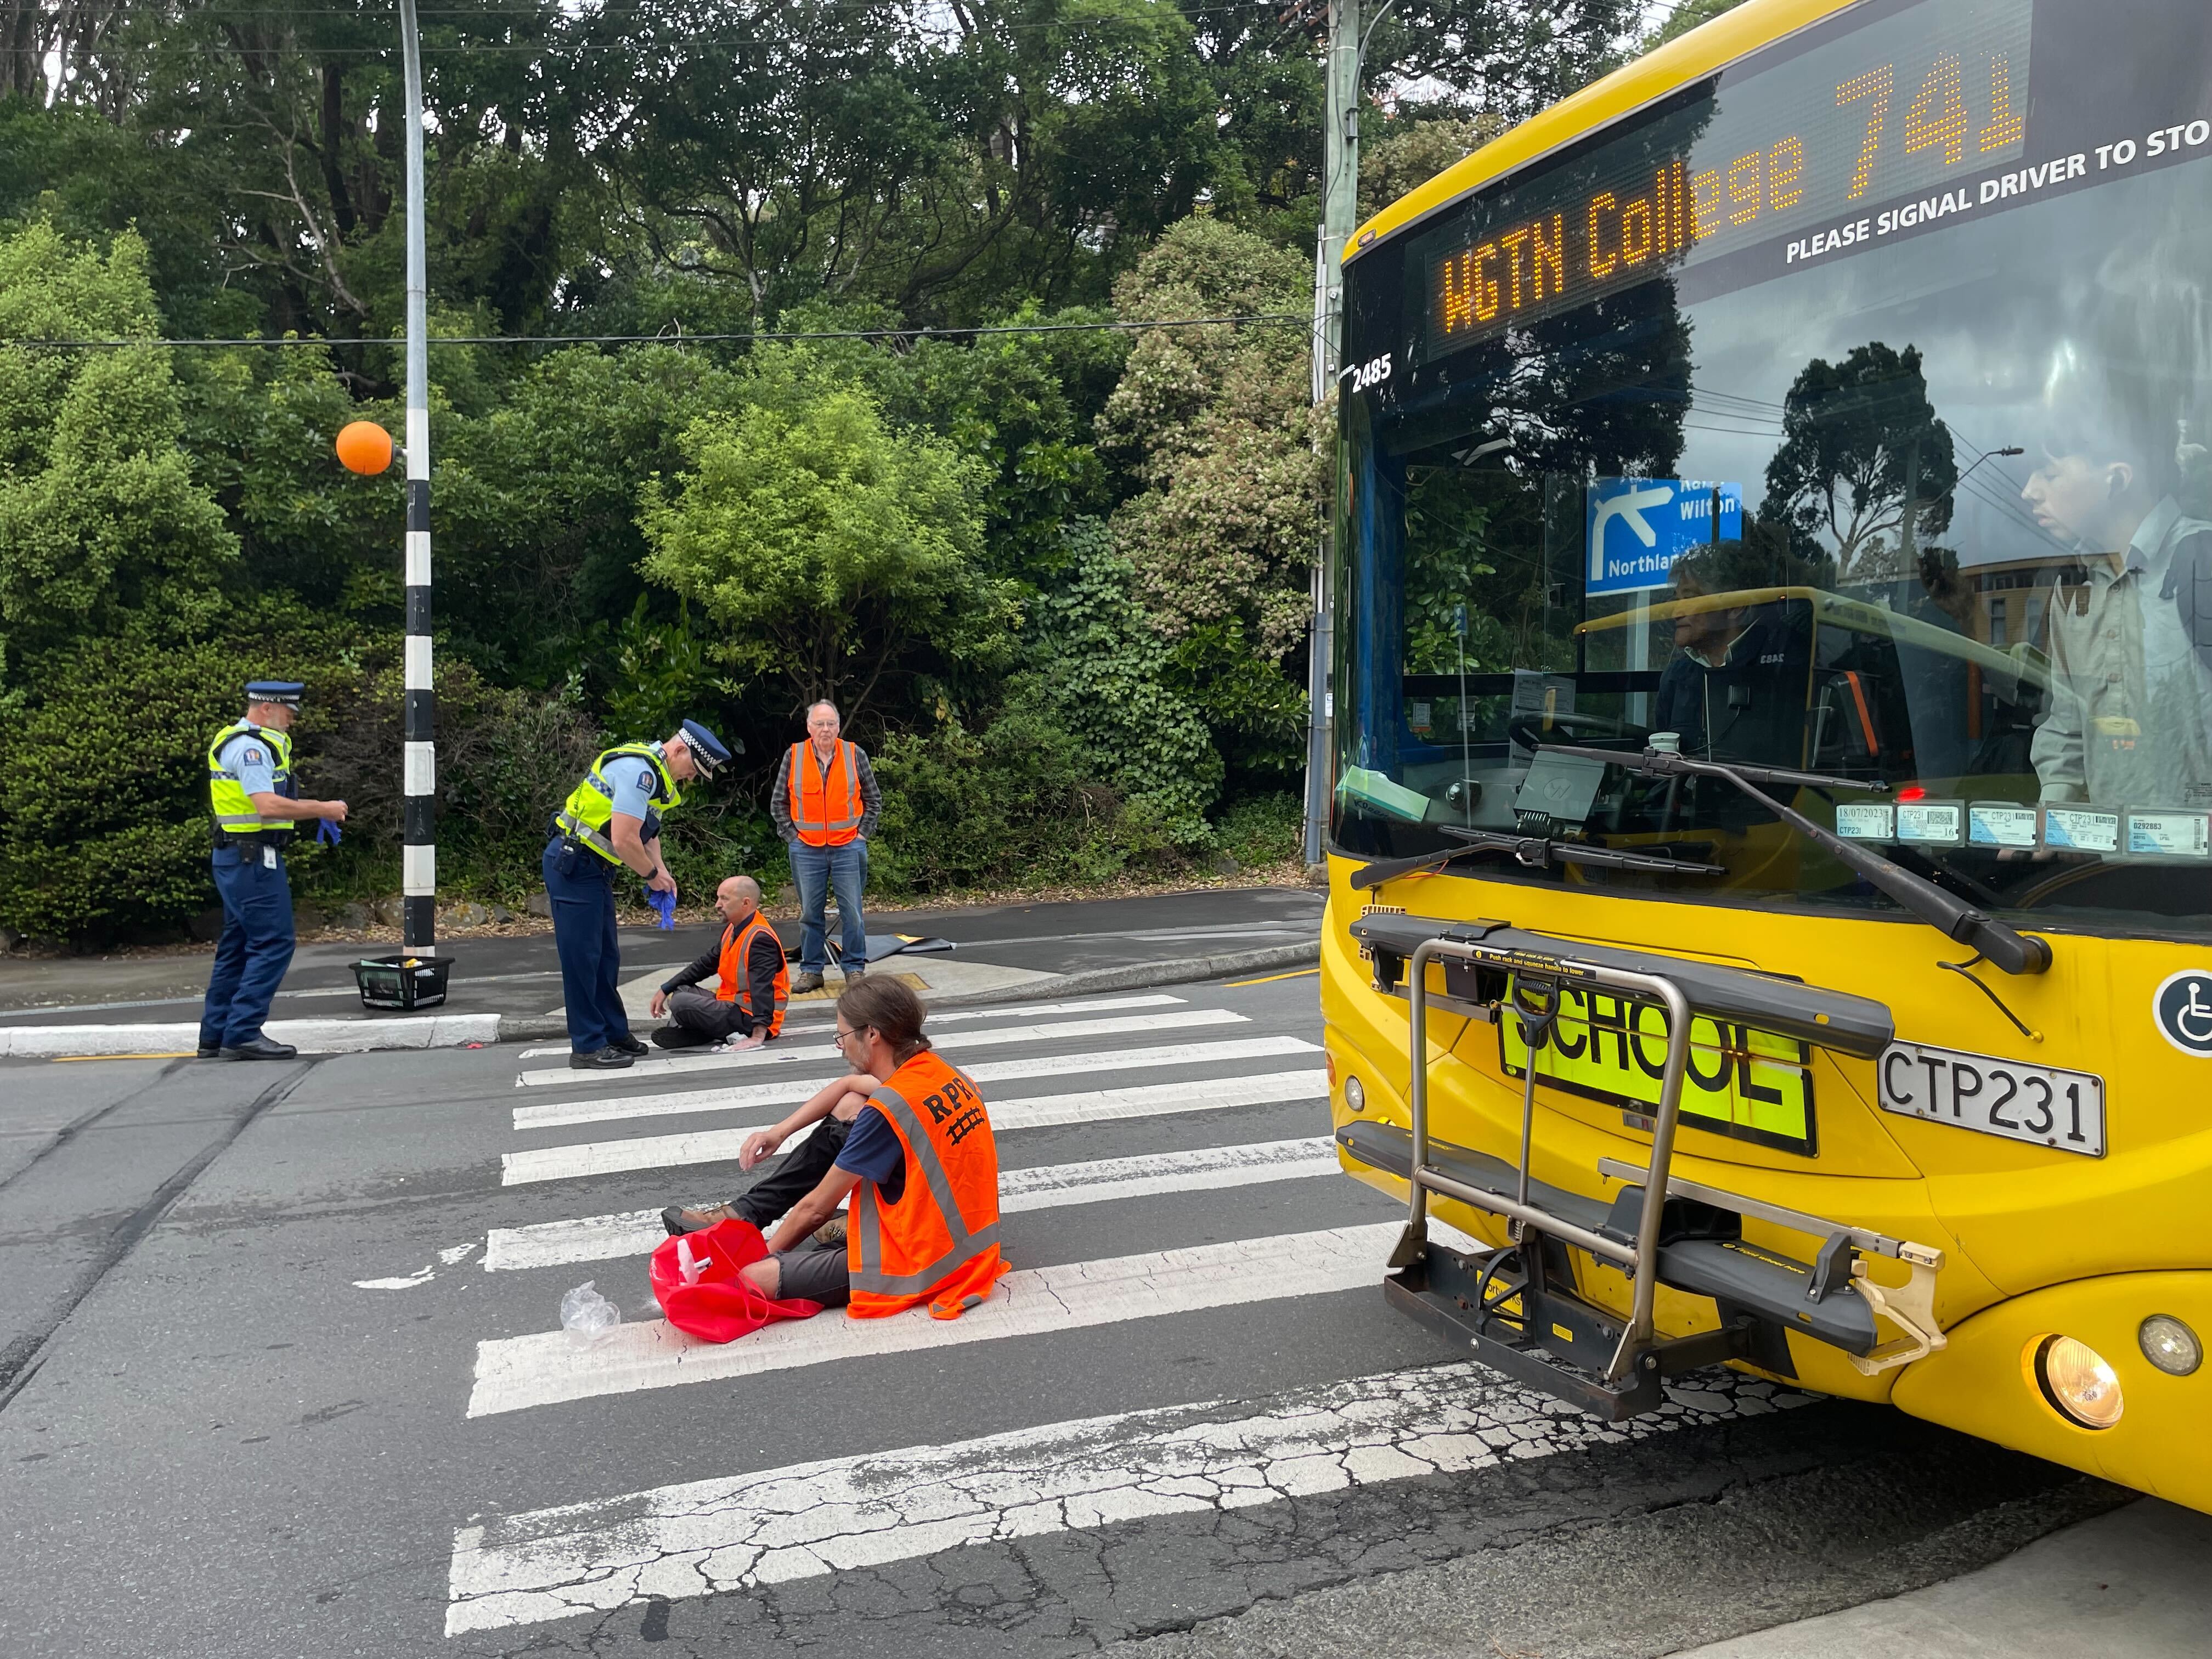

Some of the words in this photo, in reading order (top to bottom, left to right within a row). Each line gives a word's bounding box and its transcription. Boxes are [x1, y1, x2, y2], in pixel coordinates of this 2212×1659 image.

[1835, 49, 2023, 199] 741
[1786, 218, 1870, 263] PLEASE
[1877, 188, 1973, 235] SIGNAL
[1980, 153, 2086, 204] DRIVER
[2095, 139, 2136, 170] TO
[1444, 213, 1563, 333] WGTN
[1589, 136, 1803, 278] College
[1352, 352, 1392, 393] 2485
[1839, 808, 1883, 818] 18/07/2023
[1903, 810, 1924, 819] CTP231
[1991, 811, 2015, 821] CTP231
[2069, 813, 2095, 825] CTP231
[1839, 826, 1861, 834] CTP231
[1944, 828, 1954, 837] 16
[1524, 960, 1544, 969] squeeze
[1545, 962, 1562, 972] handle
[922, 1077, 973, 1125] RPR
[1884, 1051, 2085, 1142] CTP231
